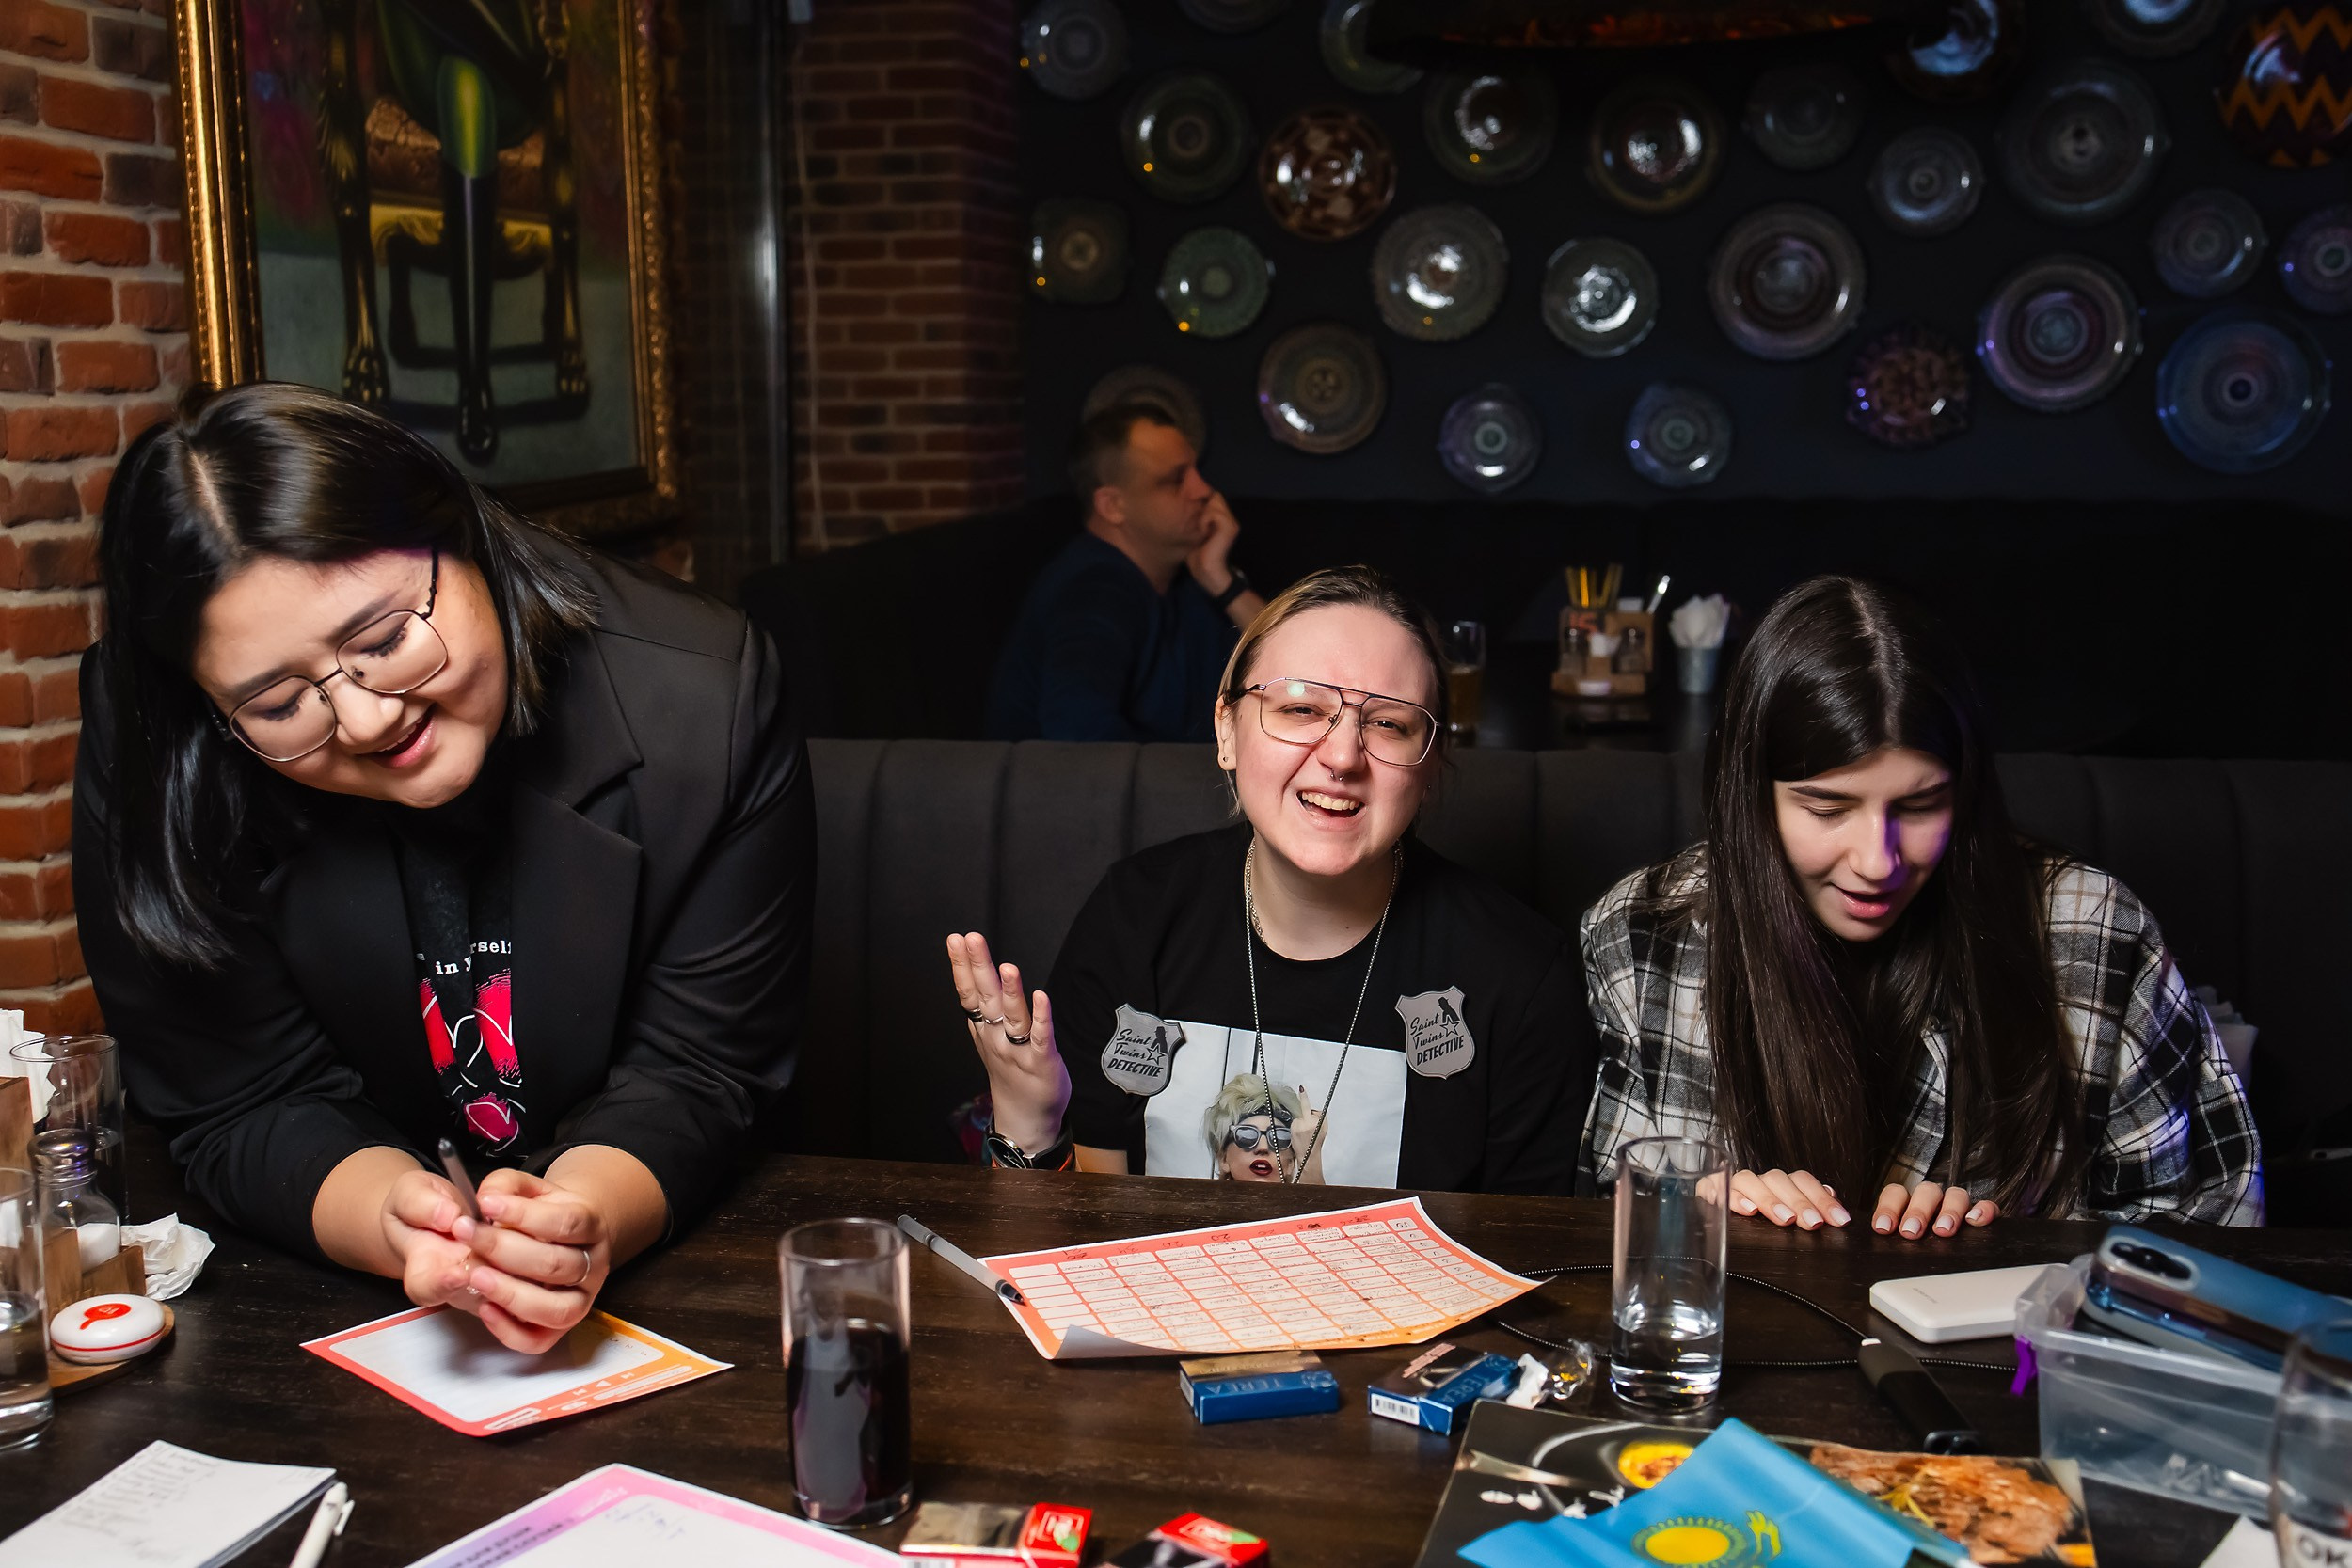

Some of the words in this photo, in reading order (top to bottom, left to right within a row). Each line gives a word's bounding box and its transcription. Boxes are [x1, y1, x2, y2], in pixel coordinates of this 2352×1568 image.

[435, 960, 459, 974] in
[1410, 1011, 1440, 1036] Saint
[1116, 1028, 1152, 1045] Saint
[1413, 1031, 1445, 1050] Twins
[1113, 1042, 1146, 1059] Twins
[1417, 1035, 1465, 1067] DETECTIVE
[1107, 1058, 1165, 1078] DETECTIVE
